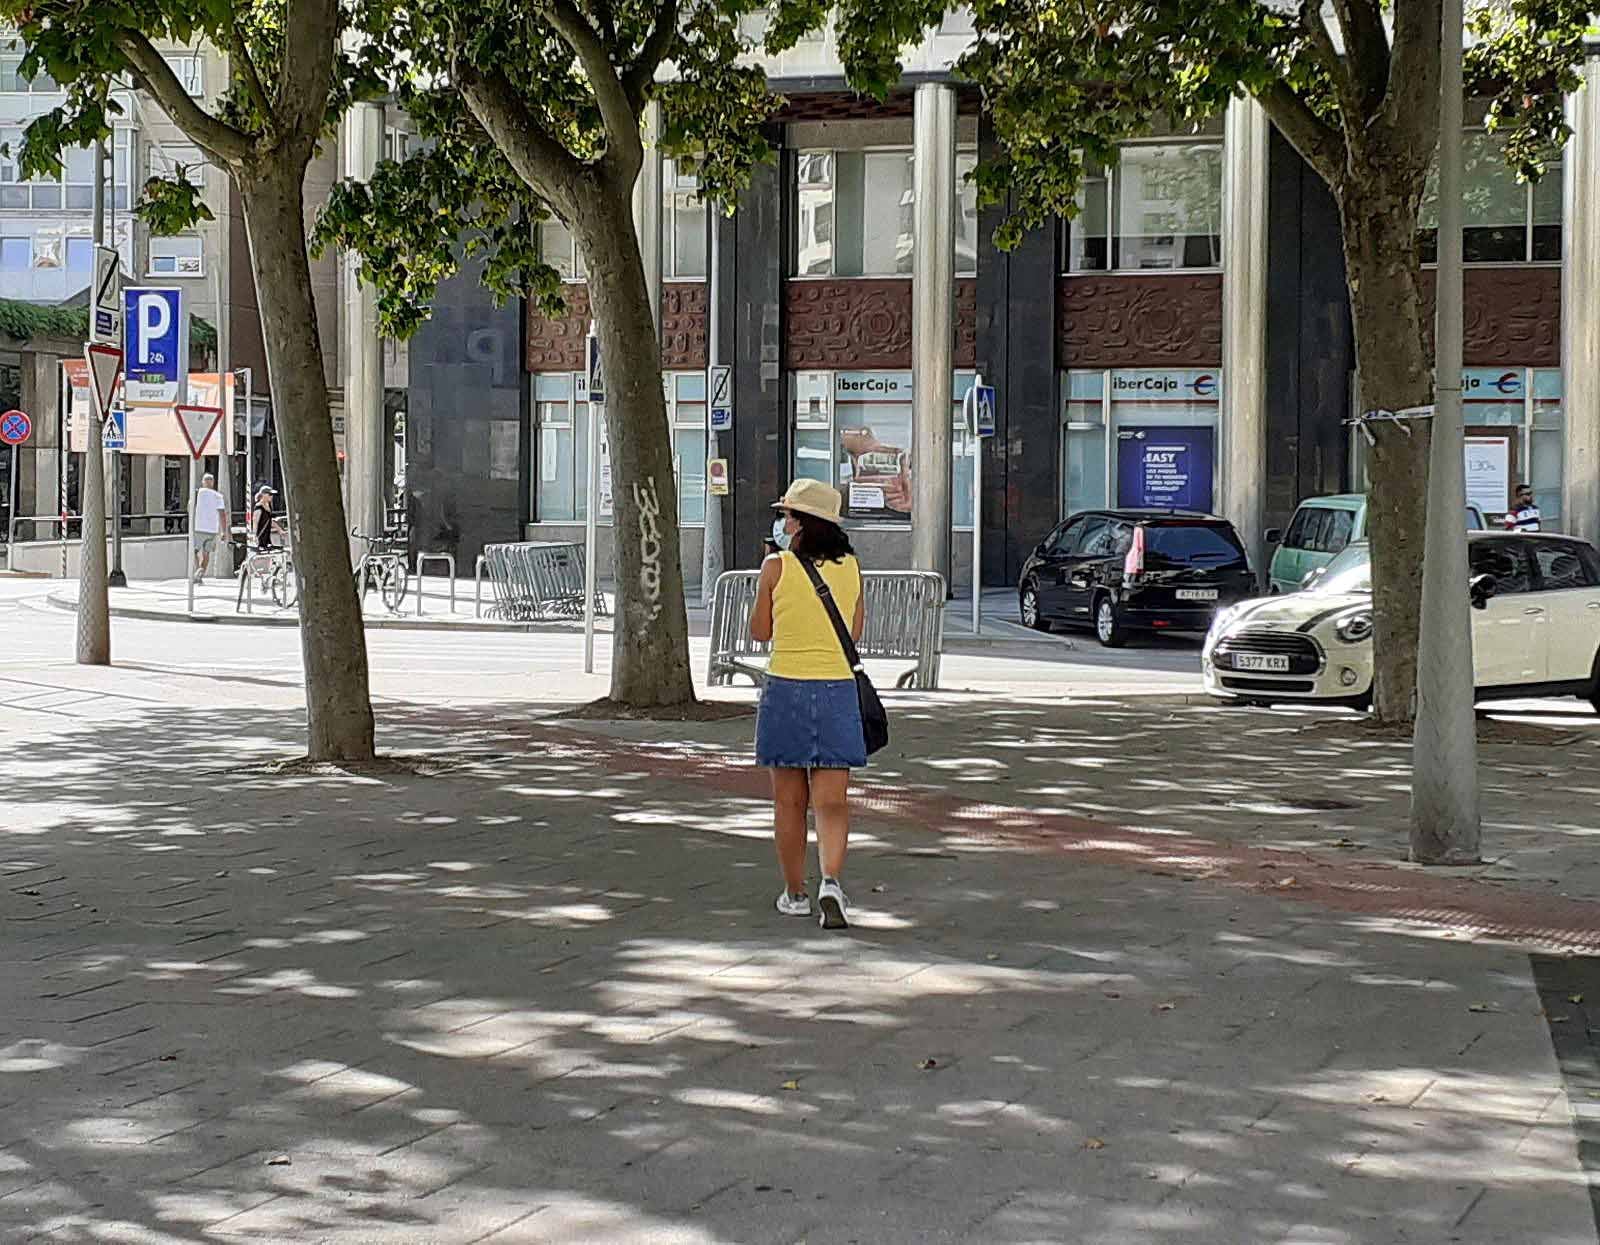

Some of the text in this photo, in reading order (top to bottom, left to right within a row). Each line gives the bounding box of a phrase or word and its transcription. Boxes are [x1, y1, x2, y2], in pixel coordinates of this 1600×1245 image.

[138, 294, 171, 364] P
[150, 351, 165, 364] 24h
[838, 378, 898, 393] iberCaja
[1113, 377, 1178, 392] iberCaja
[1239, 655, 1286, 668] 5377 KRX
